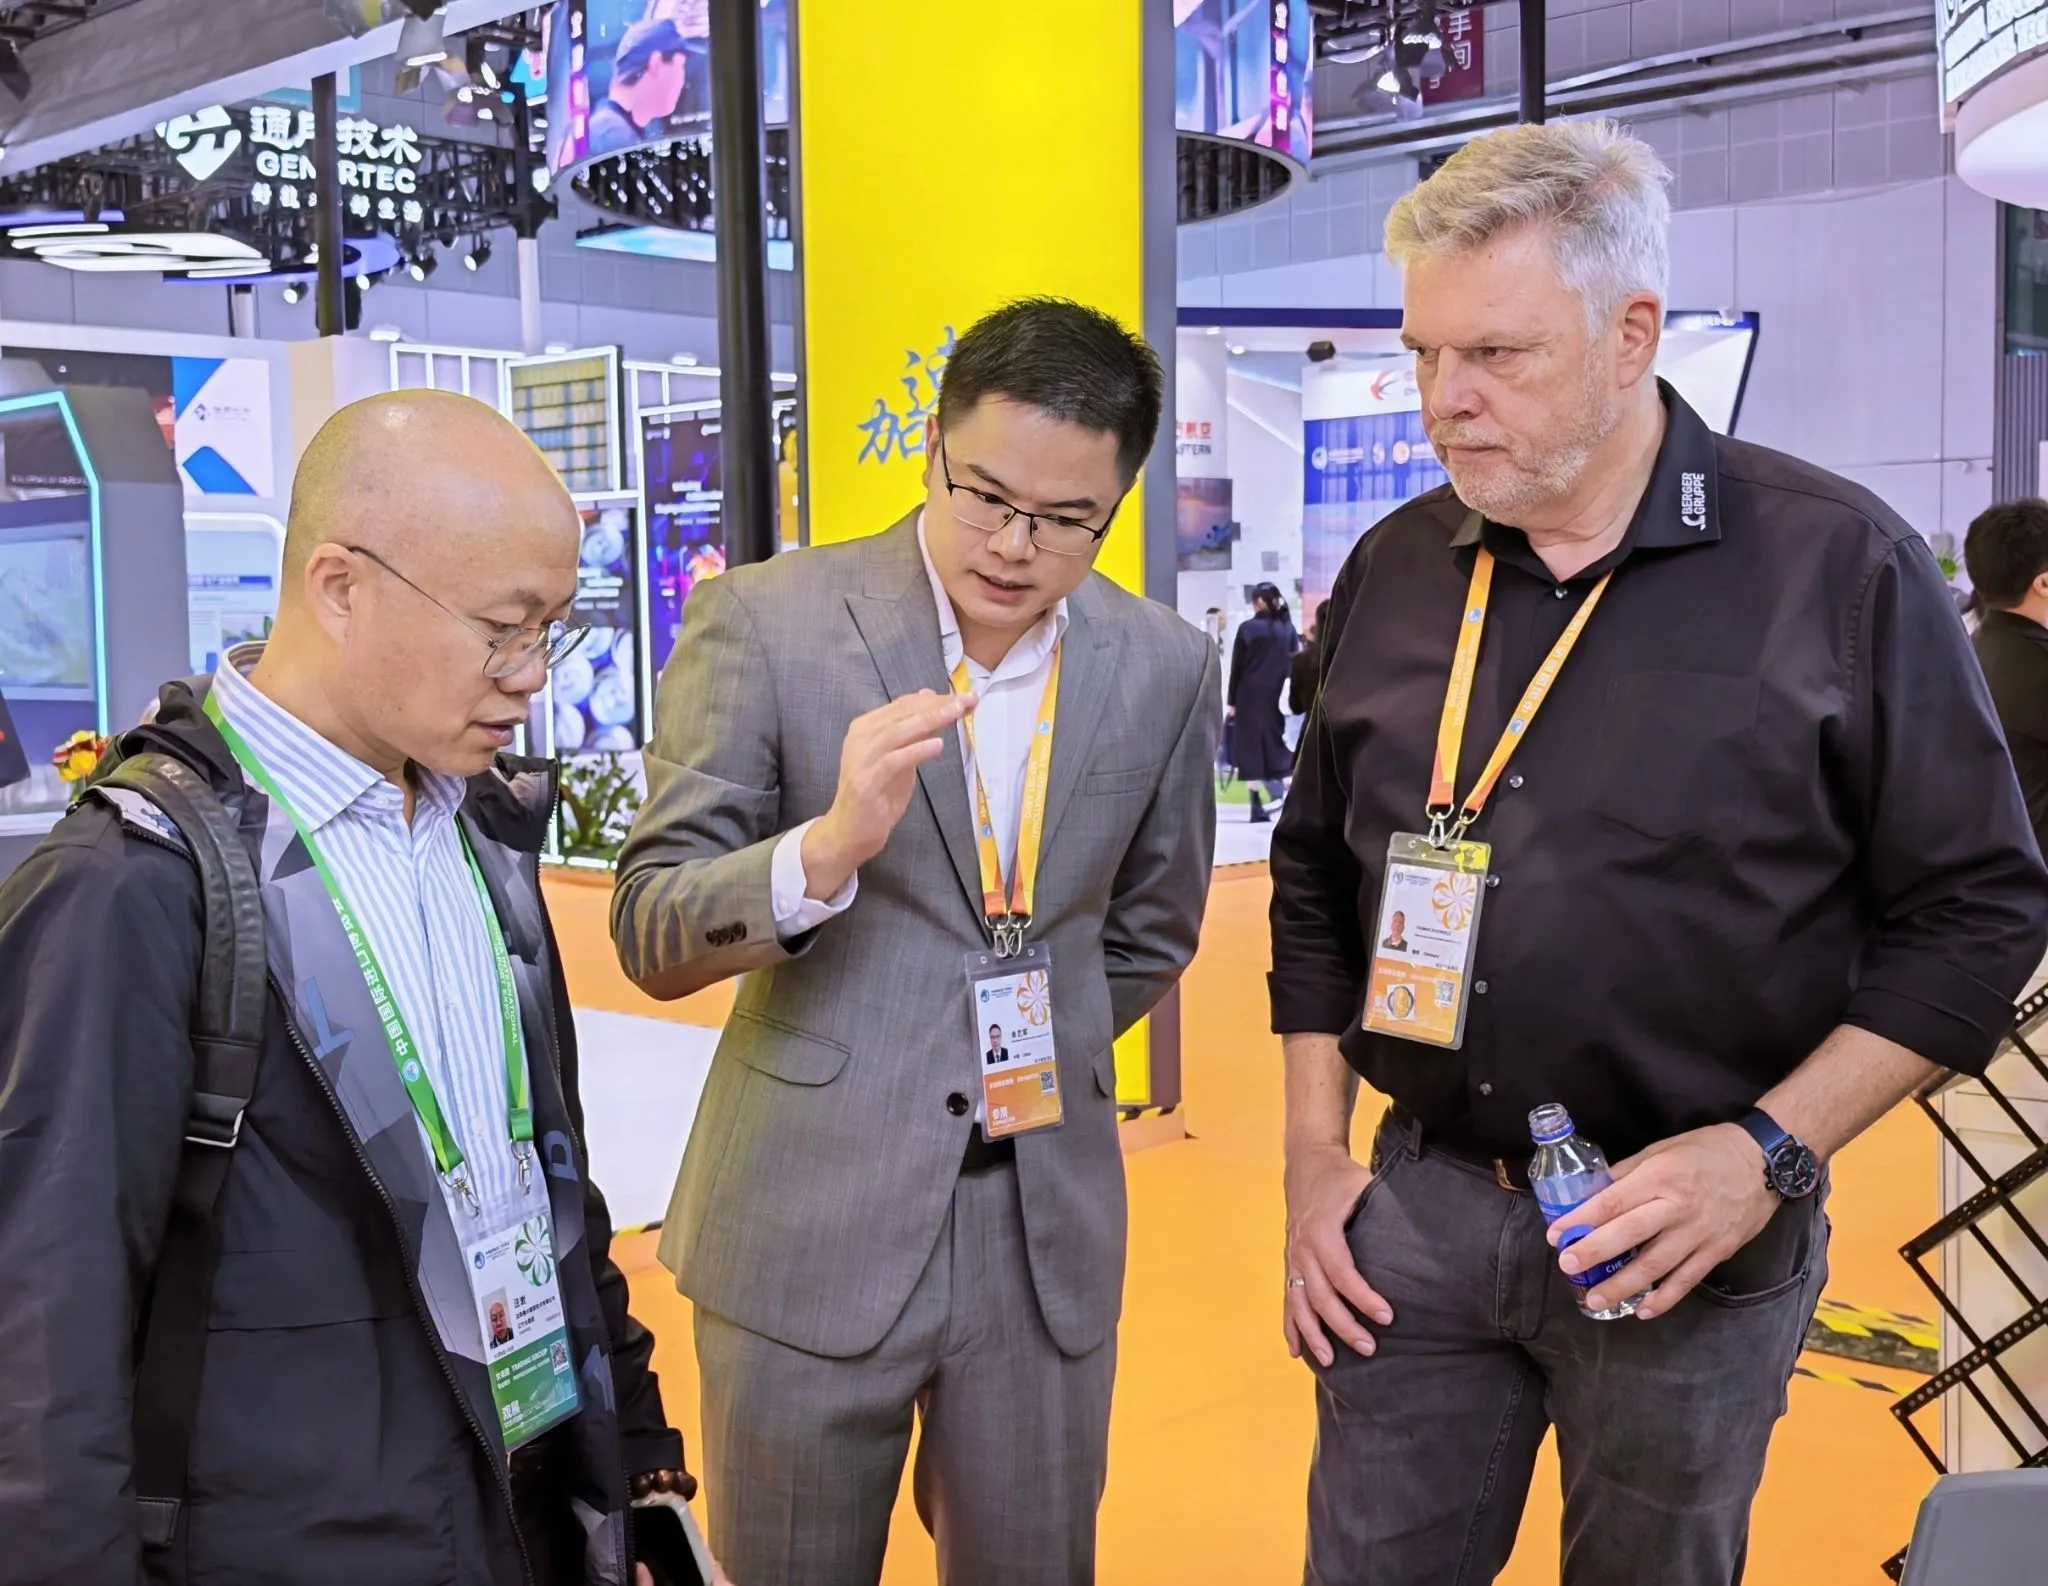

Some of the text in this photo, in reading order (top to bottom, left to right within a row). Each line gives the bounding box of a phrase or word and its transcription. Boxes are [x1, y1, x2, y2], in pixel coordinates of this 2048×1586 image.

[256, 150, 416, 194] GENRTEC
[1681, 472, 1693, 515] BERGER
[1692, 472, 1706, 515] GRUPPE
